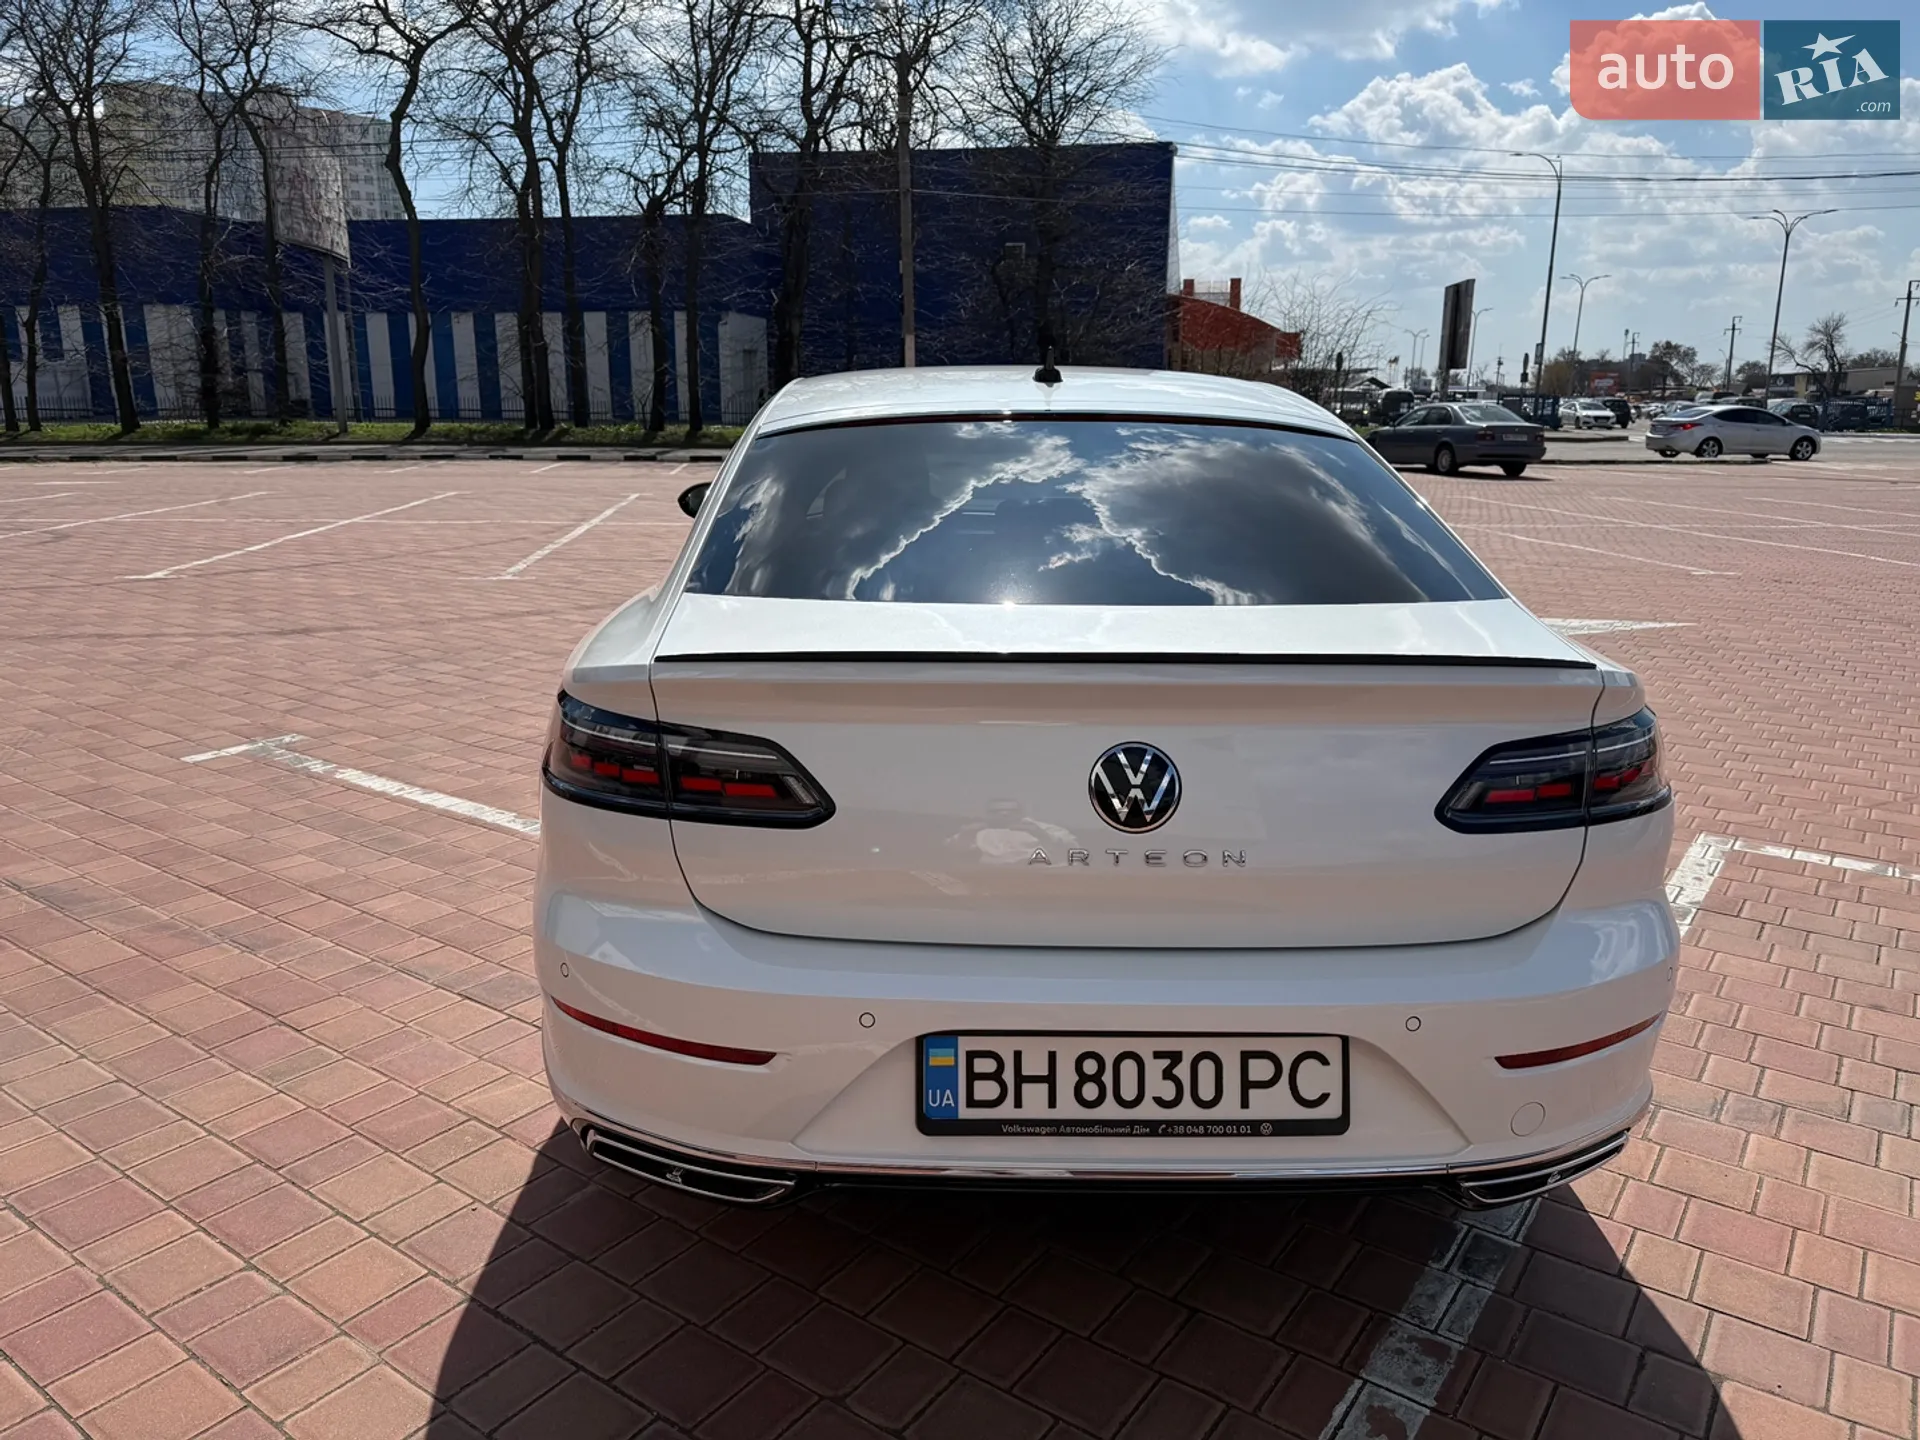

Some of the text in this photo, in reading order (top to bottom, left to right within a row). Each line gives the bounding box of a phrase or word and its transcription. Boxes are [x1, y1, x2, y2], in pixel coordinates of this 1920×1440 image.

[1028, 848, 1248, 867] ARTEON
[965, 1050, 1331, 1110] BH 8030 PC
[928, 1089, 955, 1108] UA
[1002, 1124, 1058, 1136] Volkswagen
[1059, 1124, 1132, 1136] Автомобільний
[1133, 1124, 1150, 1136] Дім
[1207, 1125, 1225, 1135] 700
[1226, 1125, 1237, 1135] 01
[1240, 1125, 1252, 1135] 01
